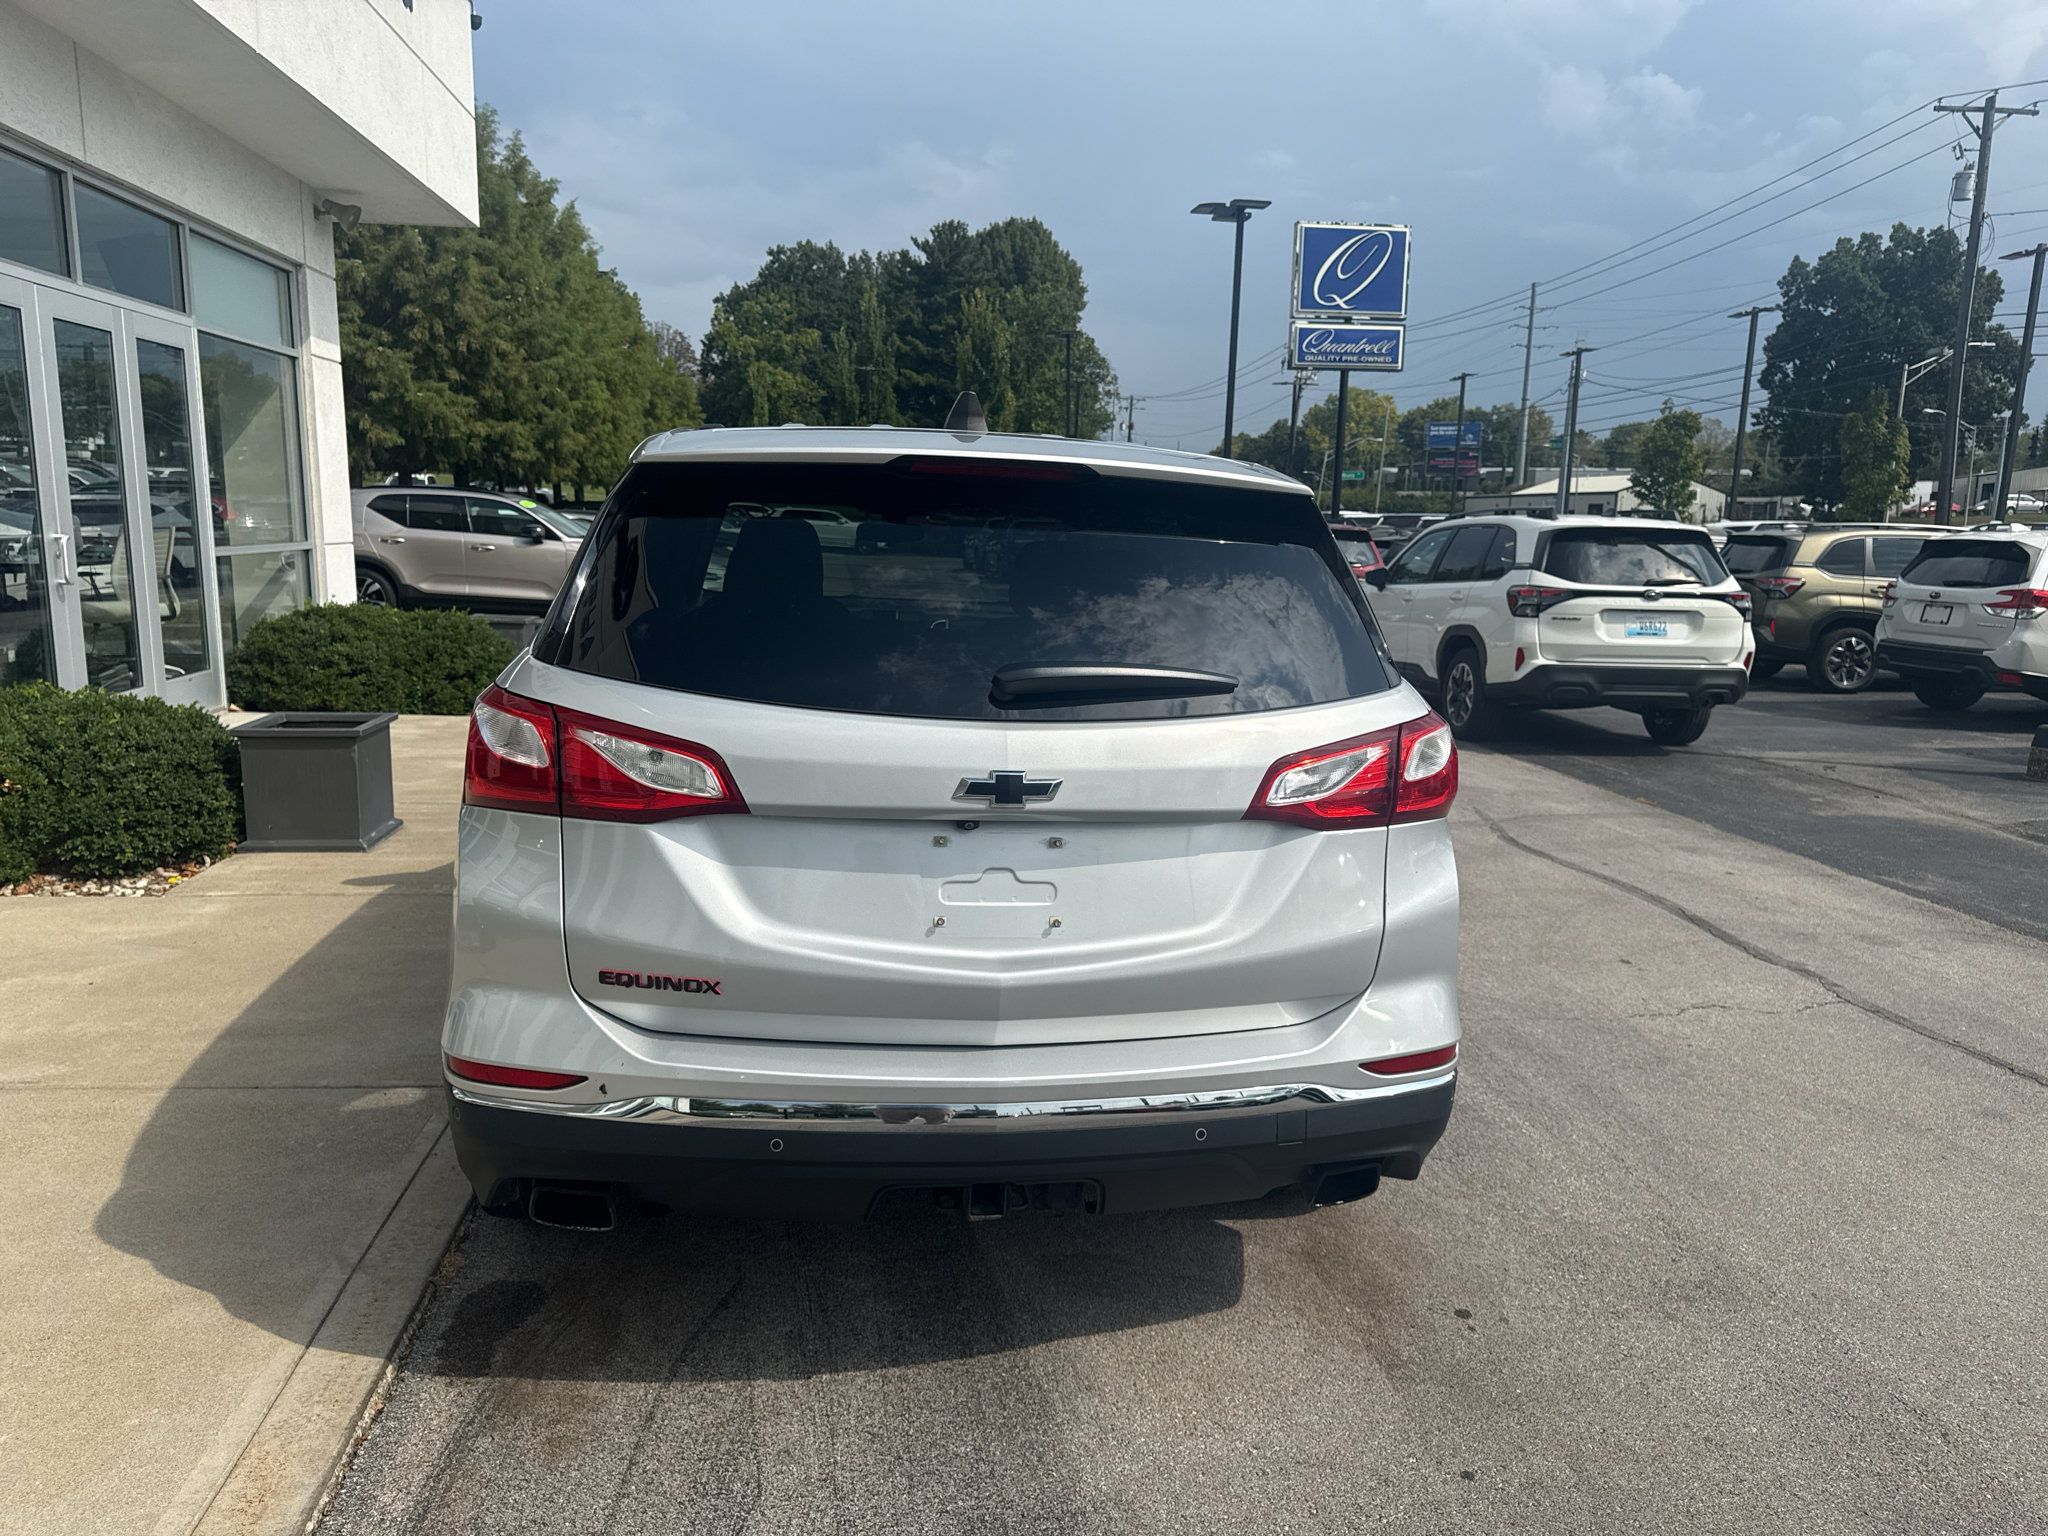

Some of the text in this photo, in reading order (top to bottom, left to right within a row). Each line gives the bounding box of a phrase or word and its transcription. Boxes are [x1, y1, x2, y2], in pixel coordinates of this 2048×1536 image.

[1313, 231, 1393, 309] Q
[1302, 329, 1396, 354] Quantrell
[1342, 355, 1392, 363] PRE-OWNED
[598, 969, 723, 996] EQUINOX
